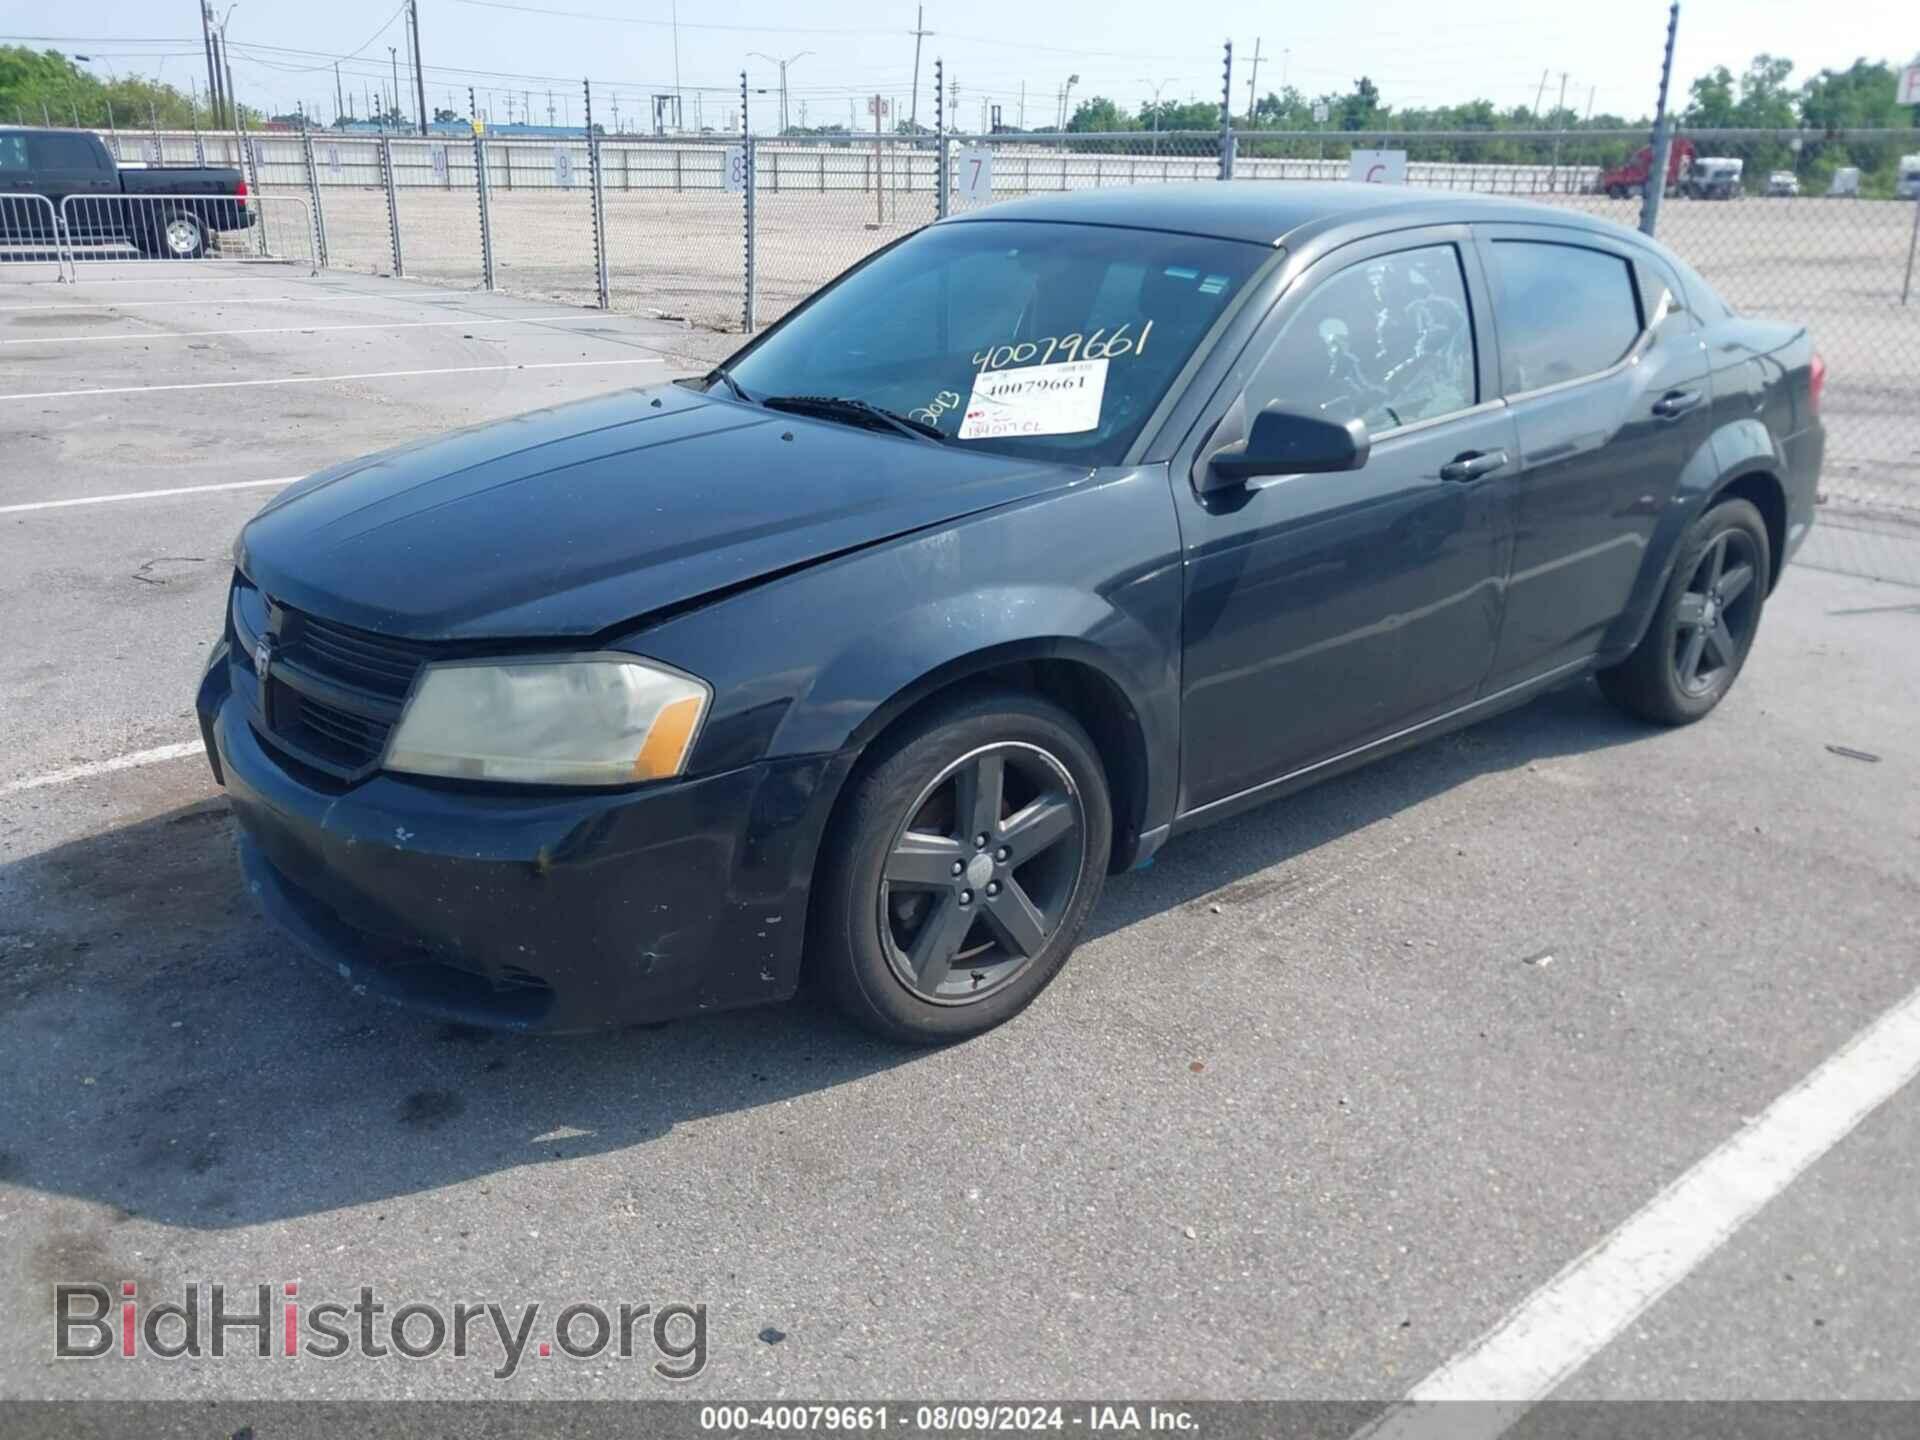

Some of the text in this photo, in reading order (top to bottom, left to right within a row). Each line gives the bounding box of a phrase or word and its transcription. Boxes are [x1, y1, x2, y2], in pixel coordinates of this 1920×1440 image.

[560, 155, 568, 178] 9
[732, 156, 741, 183] 8
[969, 159, 982, 191] 7
[972, 319, 1154, 373] 40079661
[985, 376, 1086, 397] 40079661
[908, 390, 960, 427] 2013
